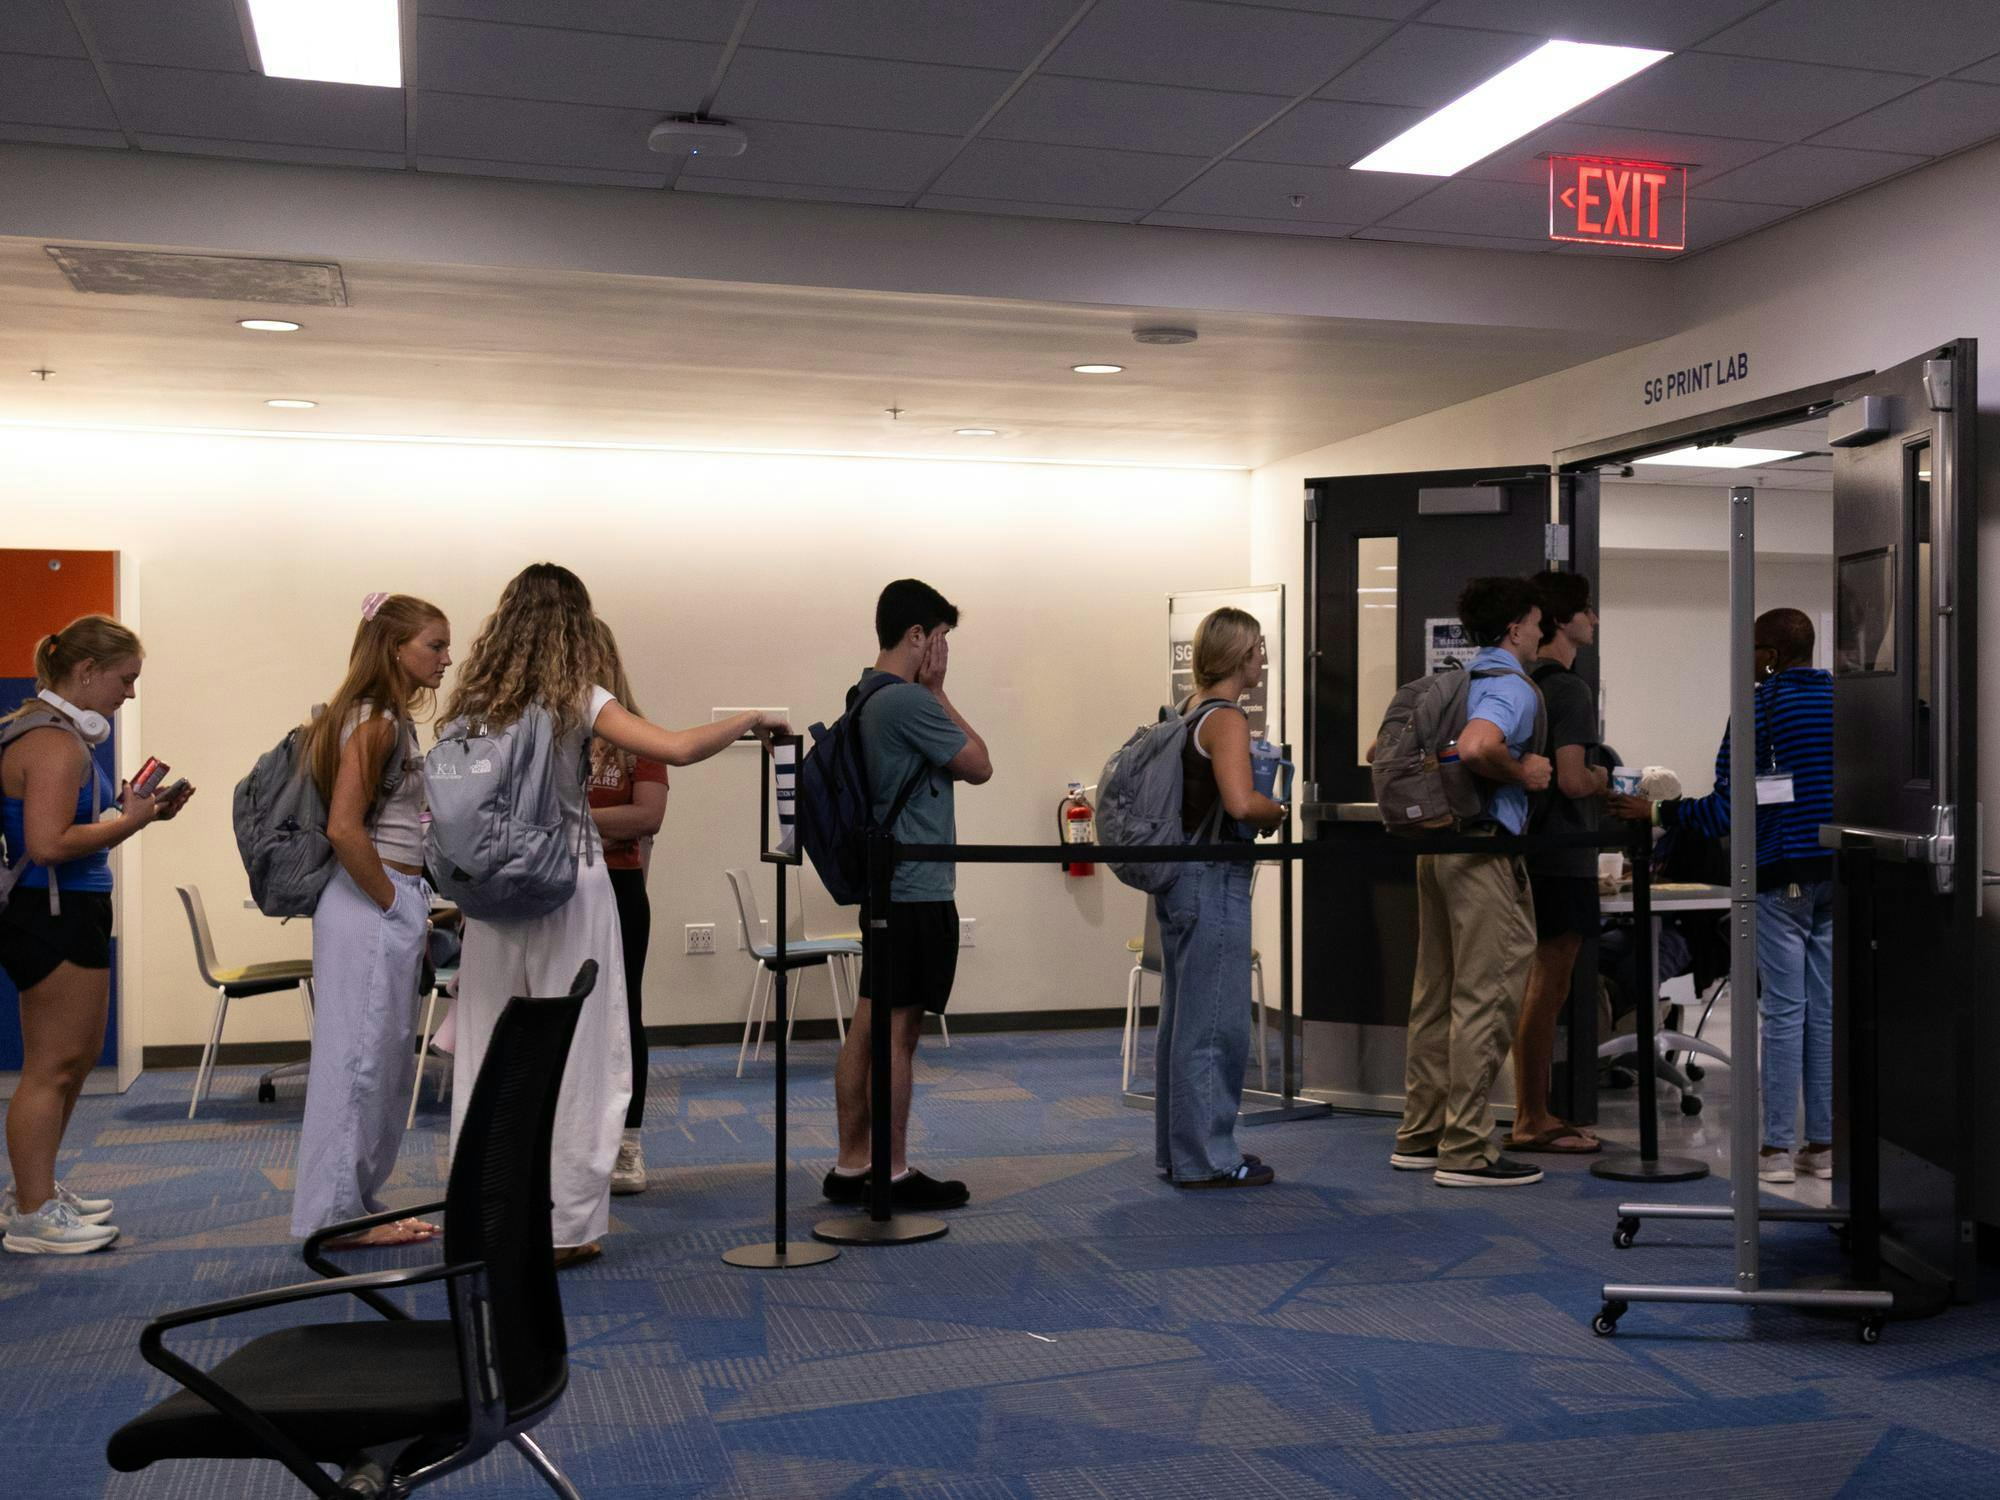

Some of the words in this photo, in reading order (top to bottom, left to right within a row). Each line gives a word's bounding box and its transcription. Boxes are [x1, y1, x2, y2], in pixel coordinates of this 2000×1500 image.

[1578, 166, 1666, 240] EXIT
[1644, 378, 1663, 405] SG
[1667, 362, 1713, 399] PRINT
[1717, 352, 1748, 385] LAB
[588, 775, 619, 787] TARS
